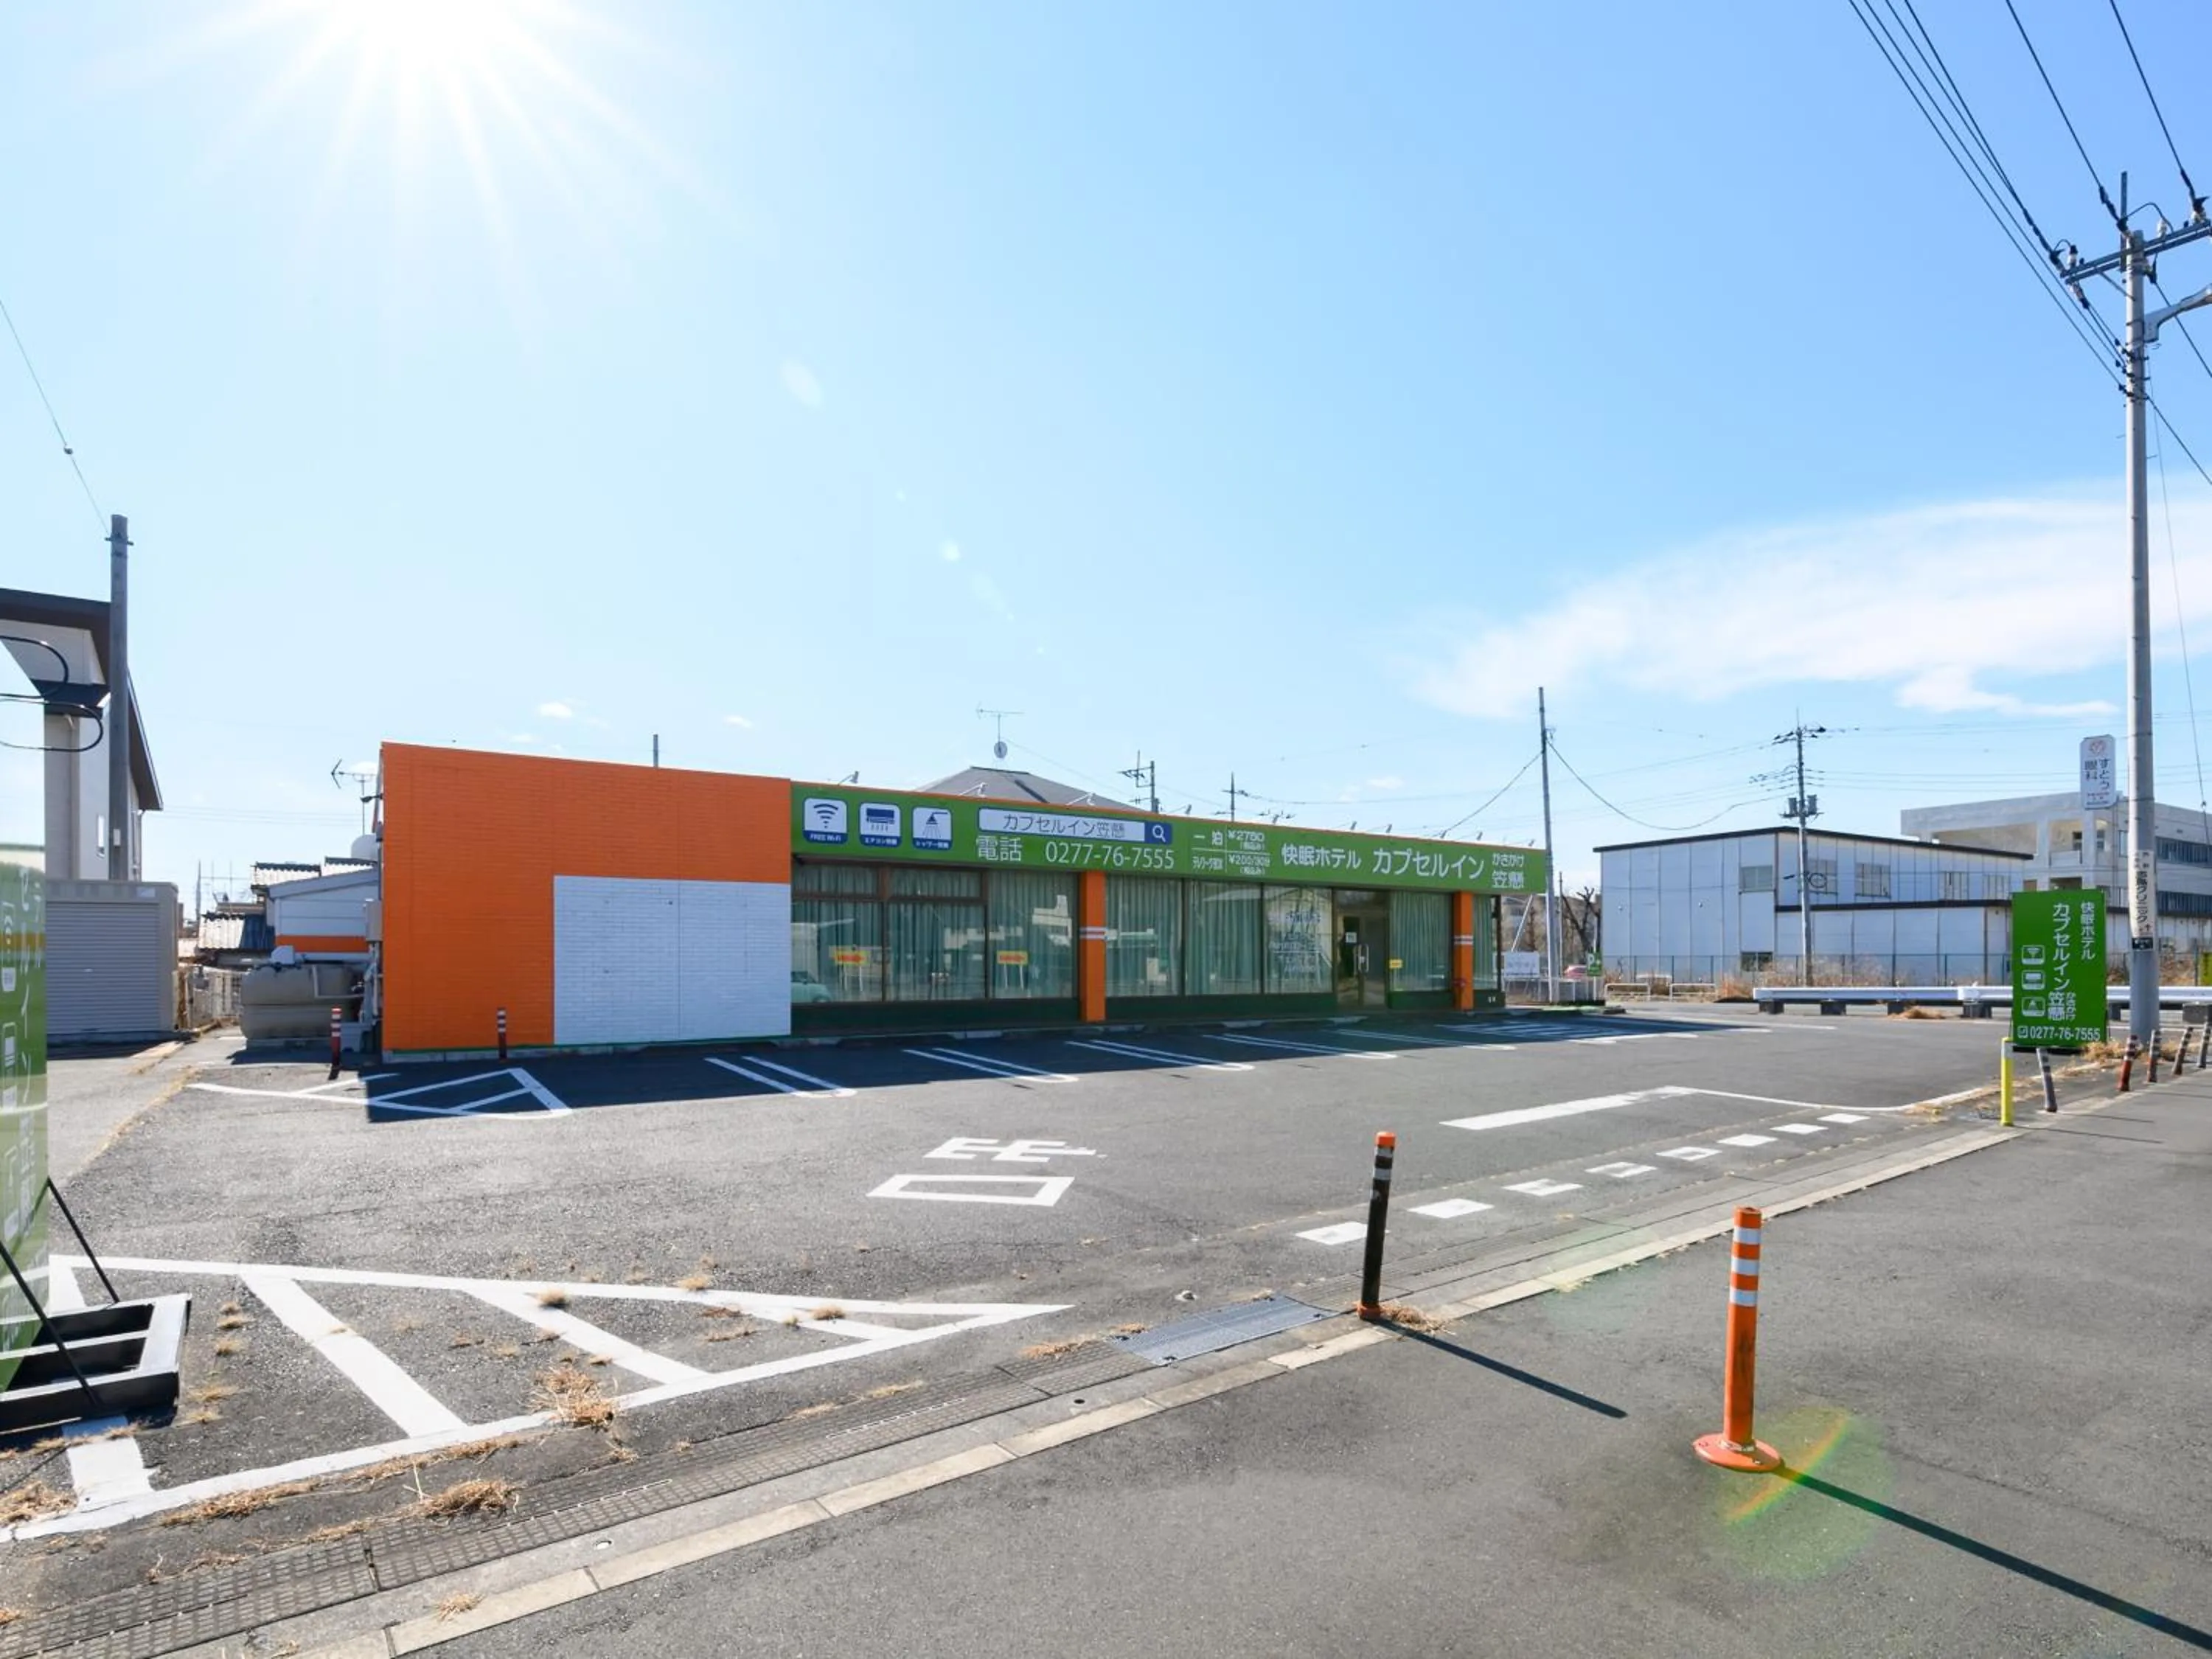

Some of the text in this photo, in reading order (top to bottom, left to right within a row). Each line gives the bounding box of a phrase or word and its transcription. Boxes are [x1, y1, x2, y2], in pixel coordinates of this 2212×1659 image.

[810, 833, 826, 841] FREE
[975, 835, 1023, 862] 電話
[1045, 841, 1175, 869] 0277-76-7555
[1281, 843, 1484, 880] 快眠ホテル カプセルイン
[2080, 901, 2096, 960] 快眠ホテル
[2029, 1026, 2101, 1041] 0277-76-7555
